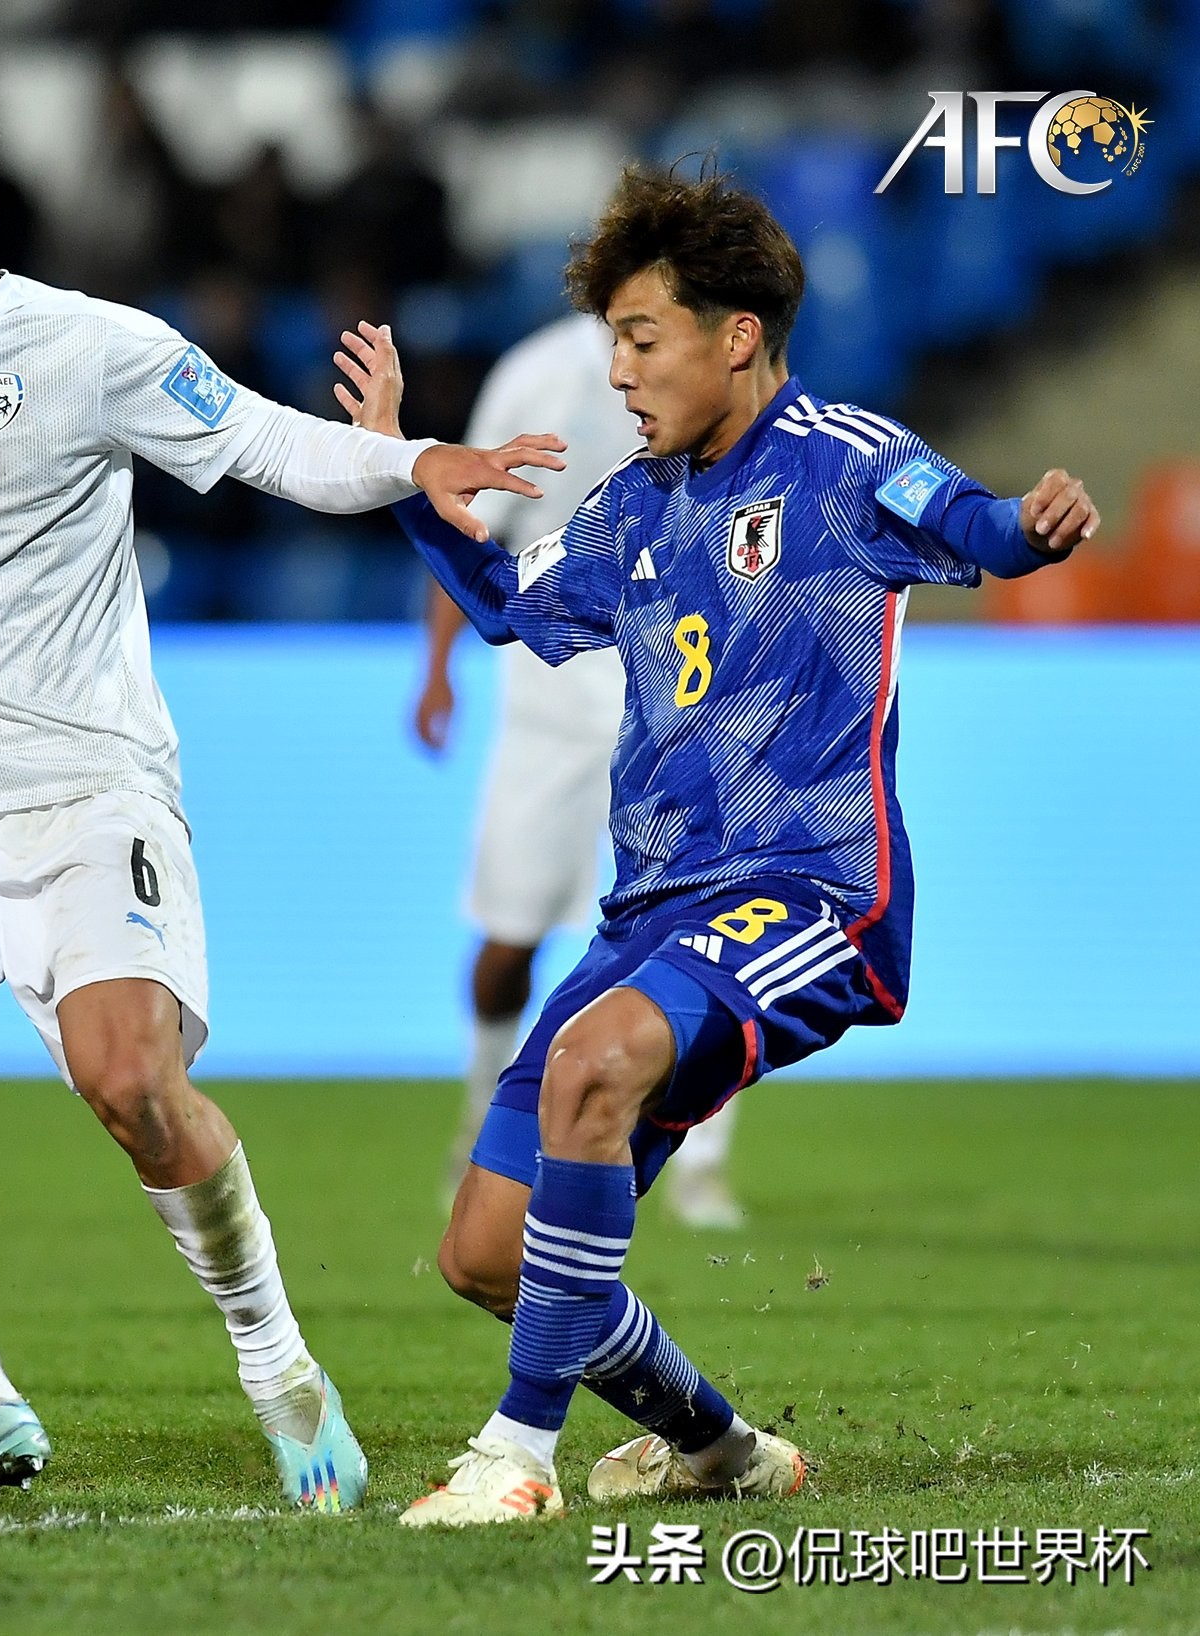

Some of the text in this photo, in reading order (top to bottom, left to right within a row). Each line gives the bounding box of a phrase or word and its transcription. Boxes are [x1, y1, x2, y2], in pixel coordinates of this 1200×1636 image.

[743, 502, 771, 516] JAPAN
[741, 553, 765, 570] JFA
[673, 613, 713, 708] 8
[130, 836, 162, 907] 6
[707, 897, 790, 945] 8
